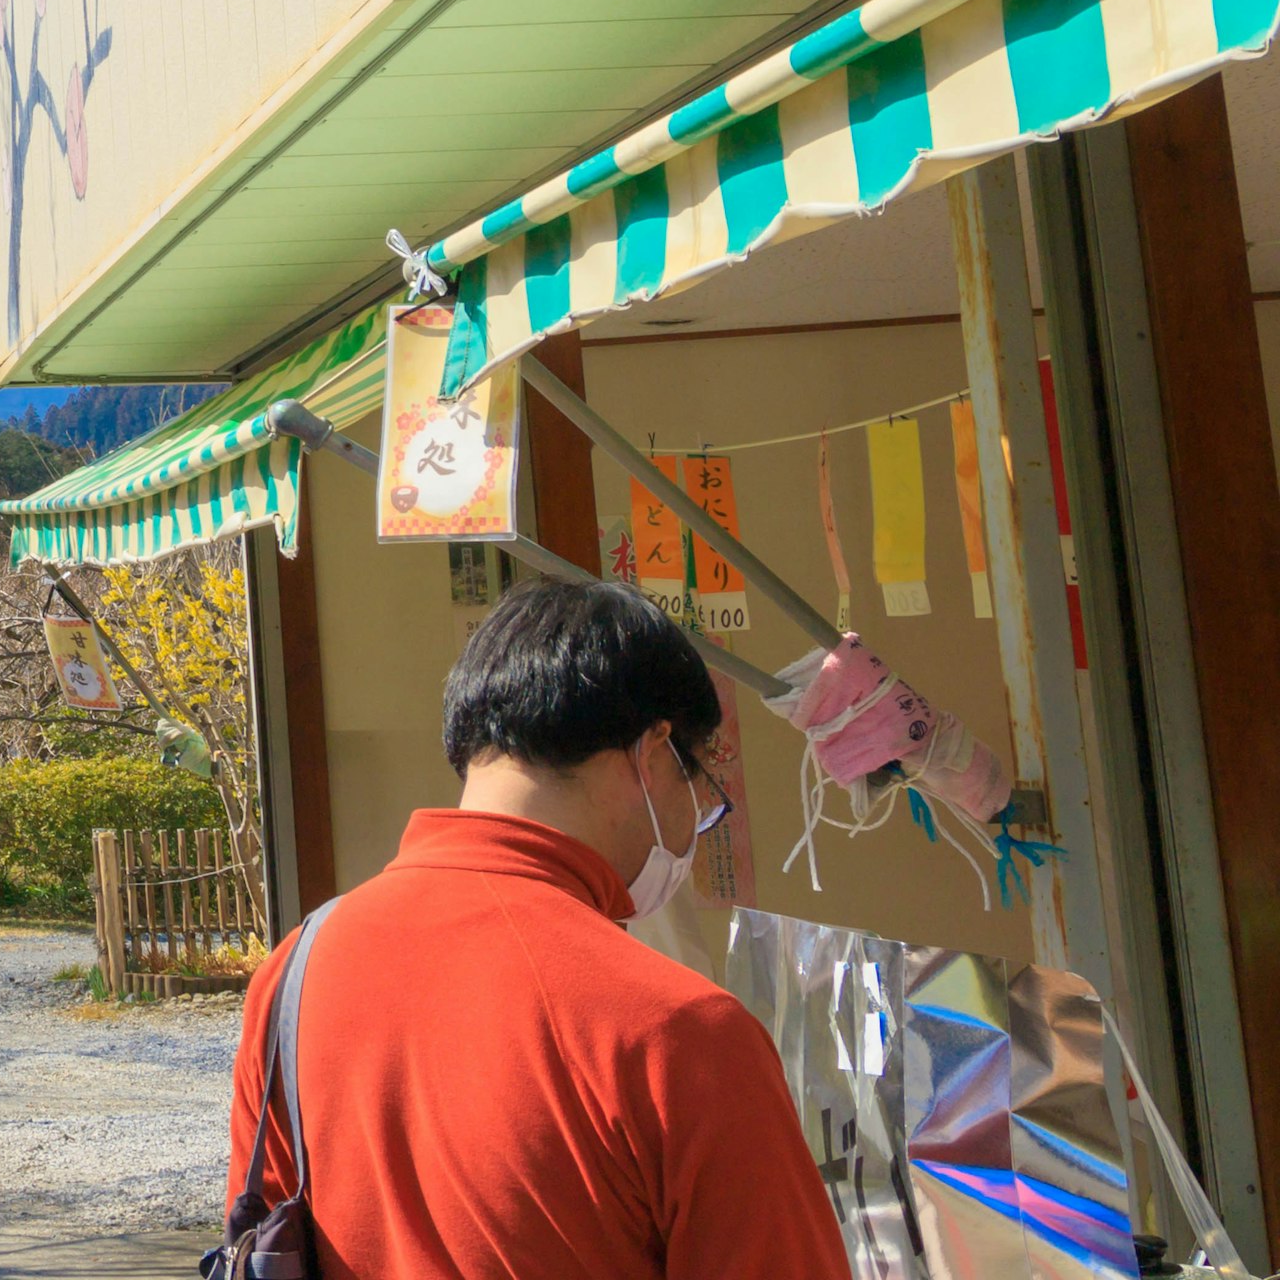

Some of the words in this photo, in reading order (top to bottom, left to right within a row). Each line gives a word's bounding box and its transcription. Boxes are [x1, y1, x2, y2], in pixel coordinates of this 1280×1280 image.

[699, 467, 729, 590] おにり
[710, 608, 745, 629] 100
